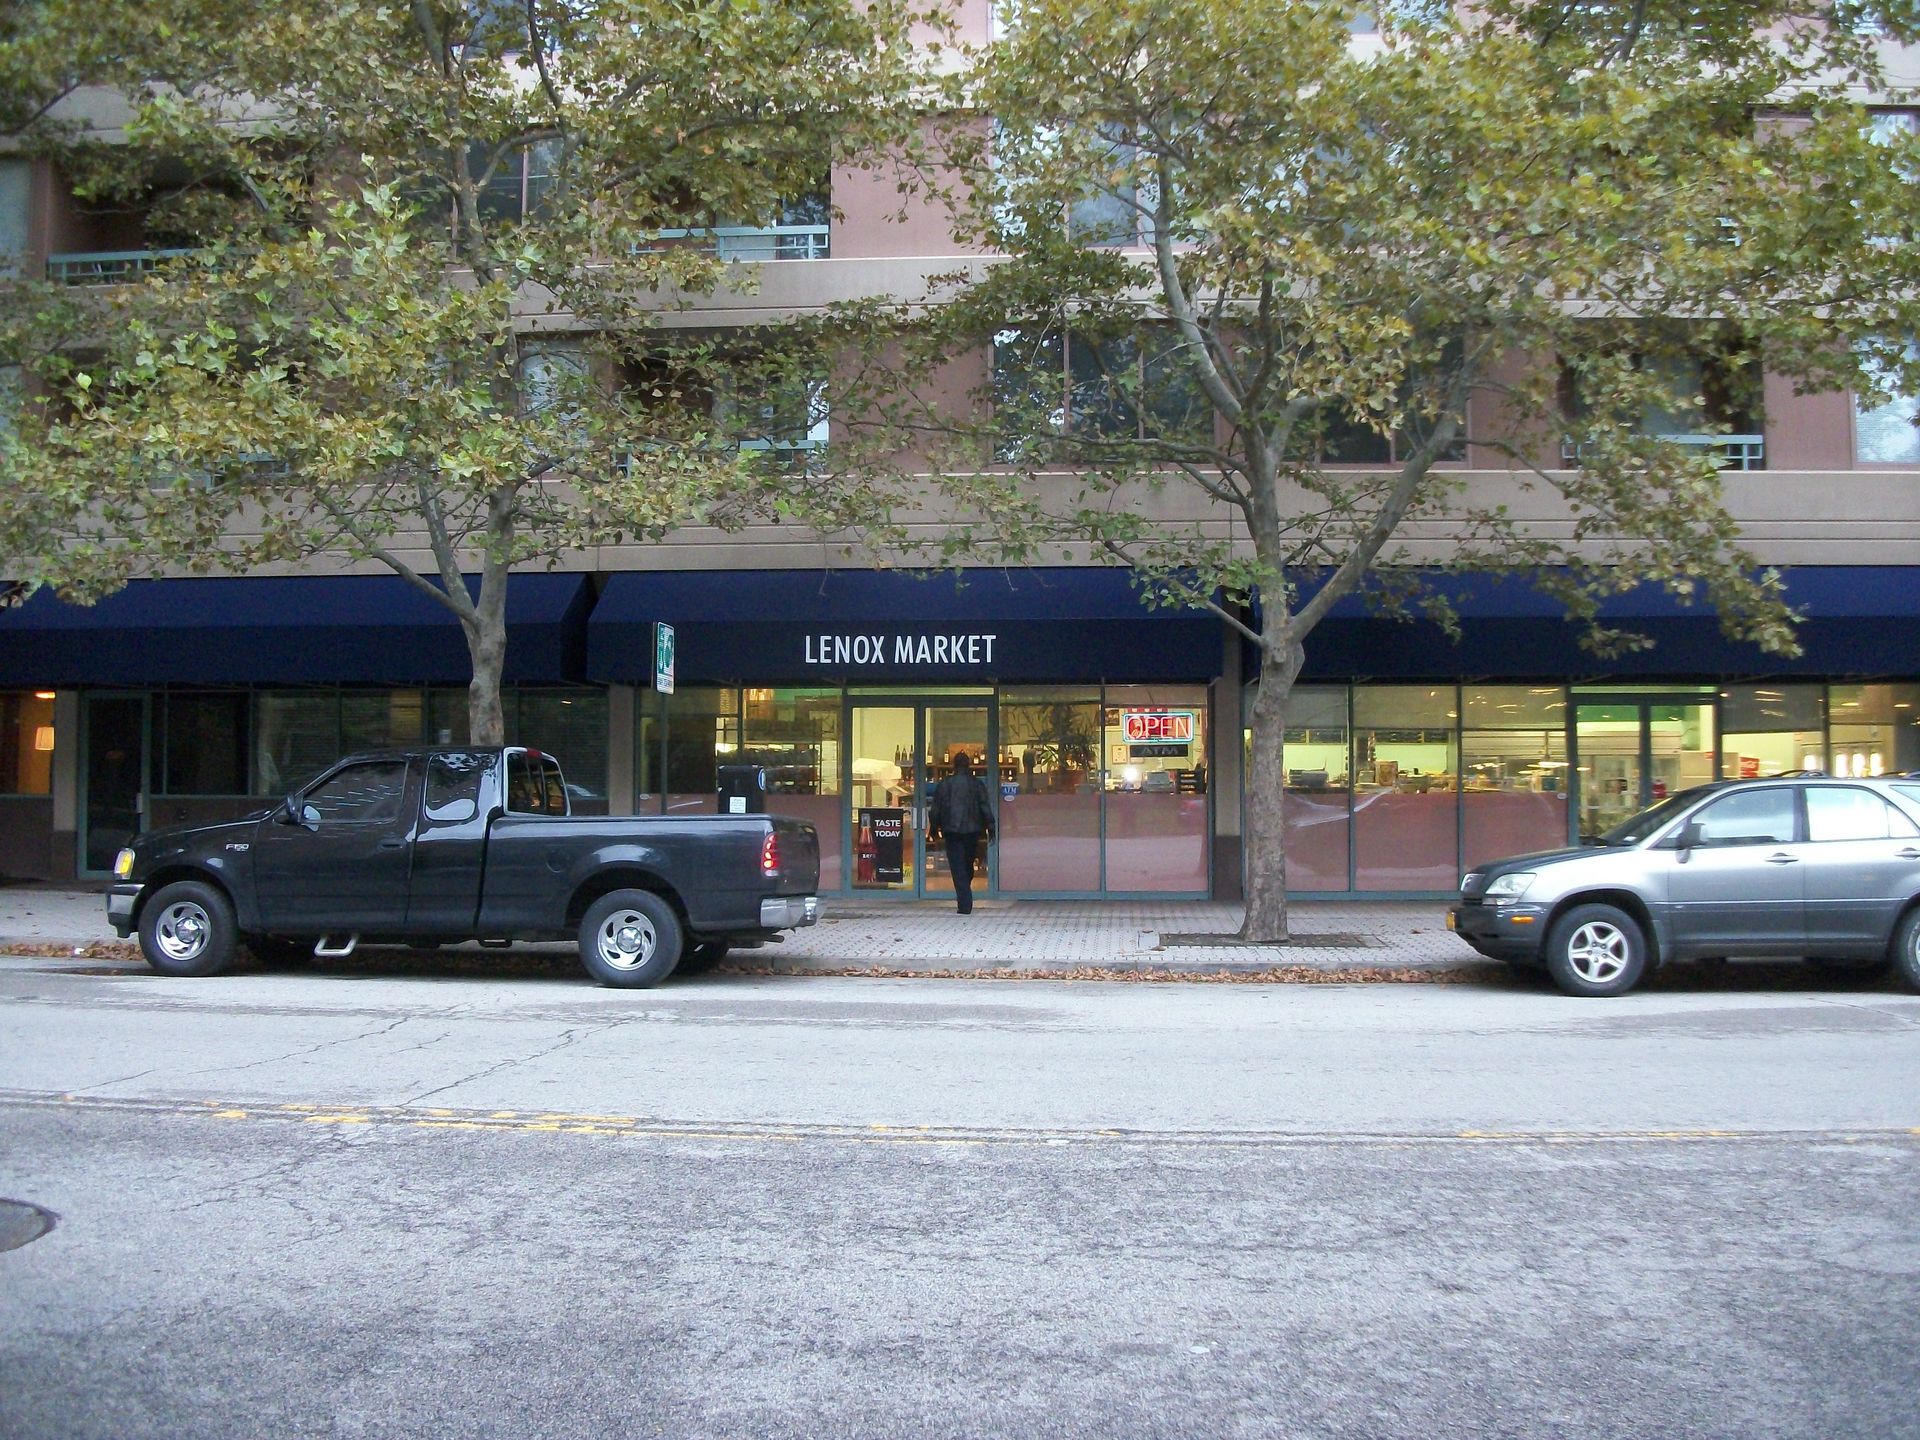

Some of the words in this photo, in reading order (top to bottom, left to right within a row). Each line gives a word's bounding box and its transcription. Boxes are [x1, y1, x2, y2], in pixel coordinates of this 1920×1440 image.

[805, 635, 885, 664] LENOX
[894, 635, 997, 663] MARKET
[1126, 715, 1191, 740] OPEN
[1141, 746, 1179, 755] ATM
[1003, 786, 1017, 795] ATM
[874, 819, 901, 827] TASTE
[874, 830, 901, 838] TODAY
